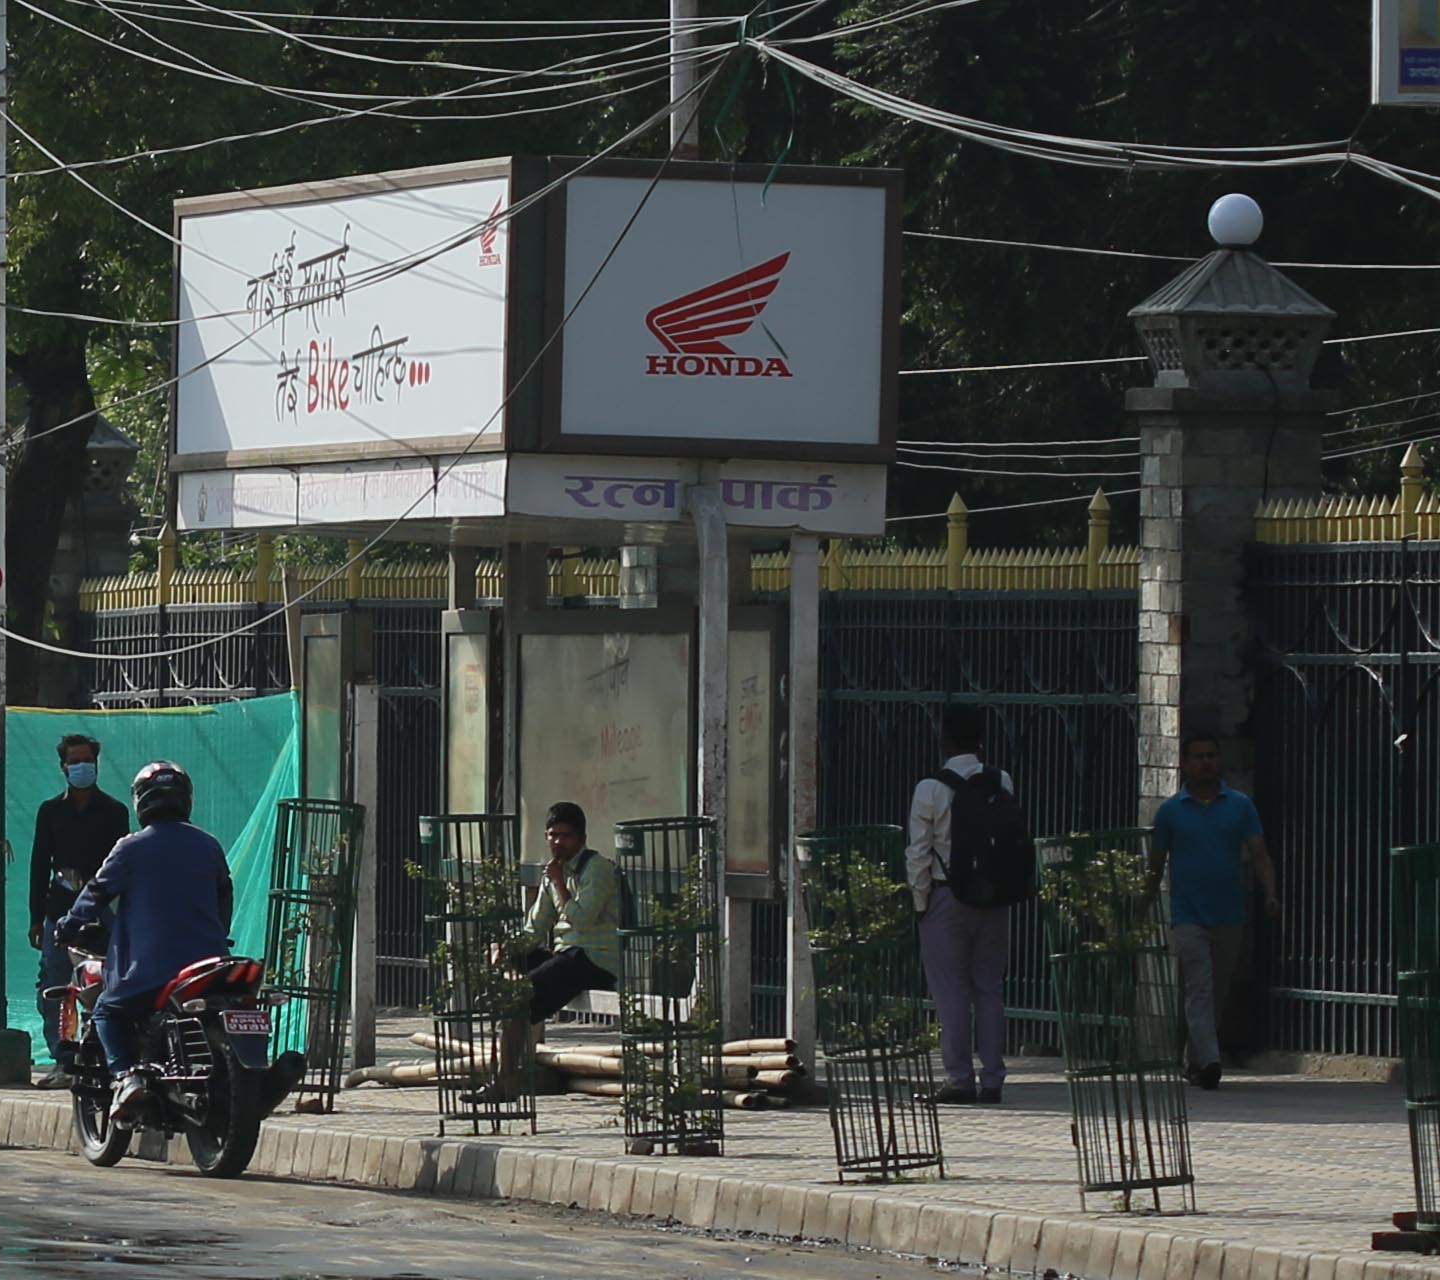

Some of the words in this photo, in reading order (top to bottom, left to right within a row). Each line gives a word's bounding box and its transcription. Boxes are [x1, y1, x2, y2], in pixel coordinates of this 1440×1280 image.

[307, 337, 350, 414] Bike
[644, 354, 794, 378] HONDA
[563, 475, 680, 510] रत्न
[719, 473, 837, 512] पार्क
[1041, 845, 1073, 864] KMC
